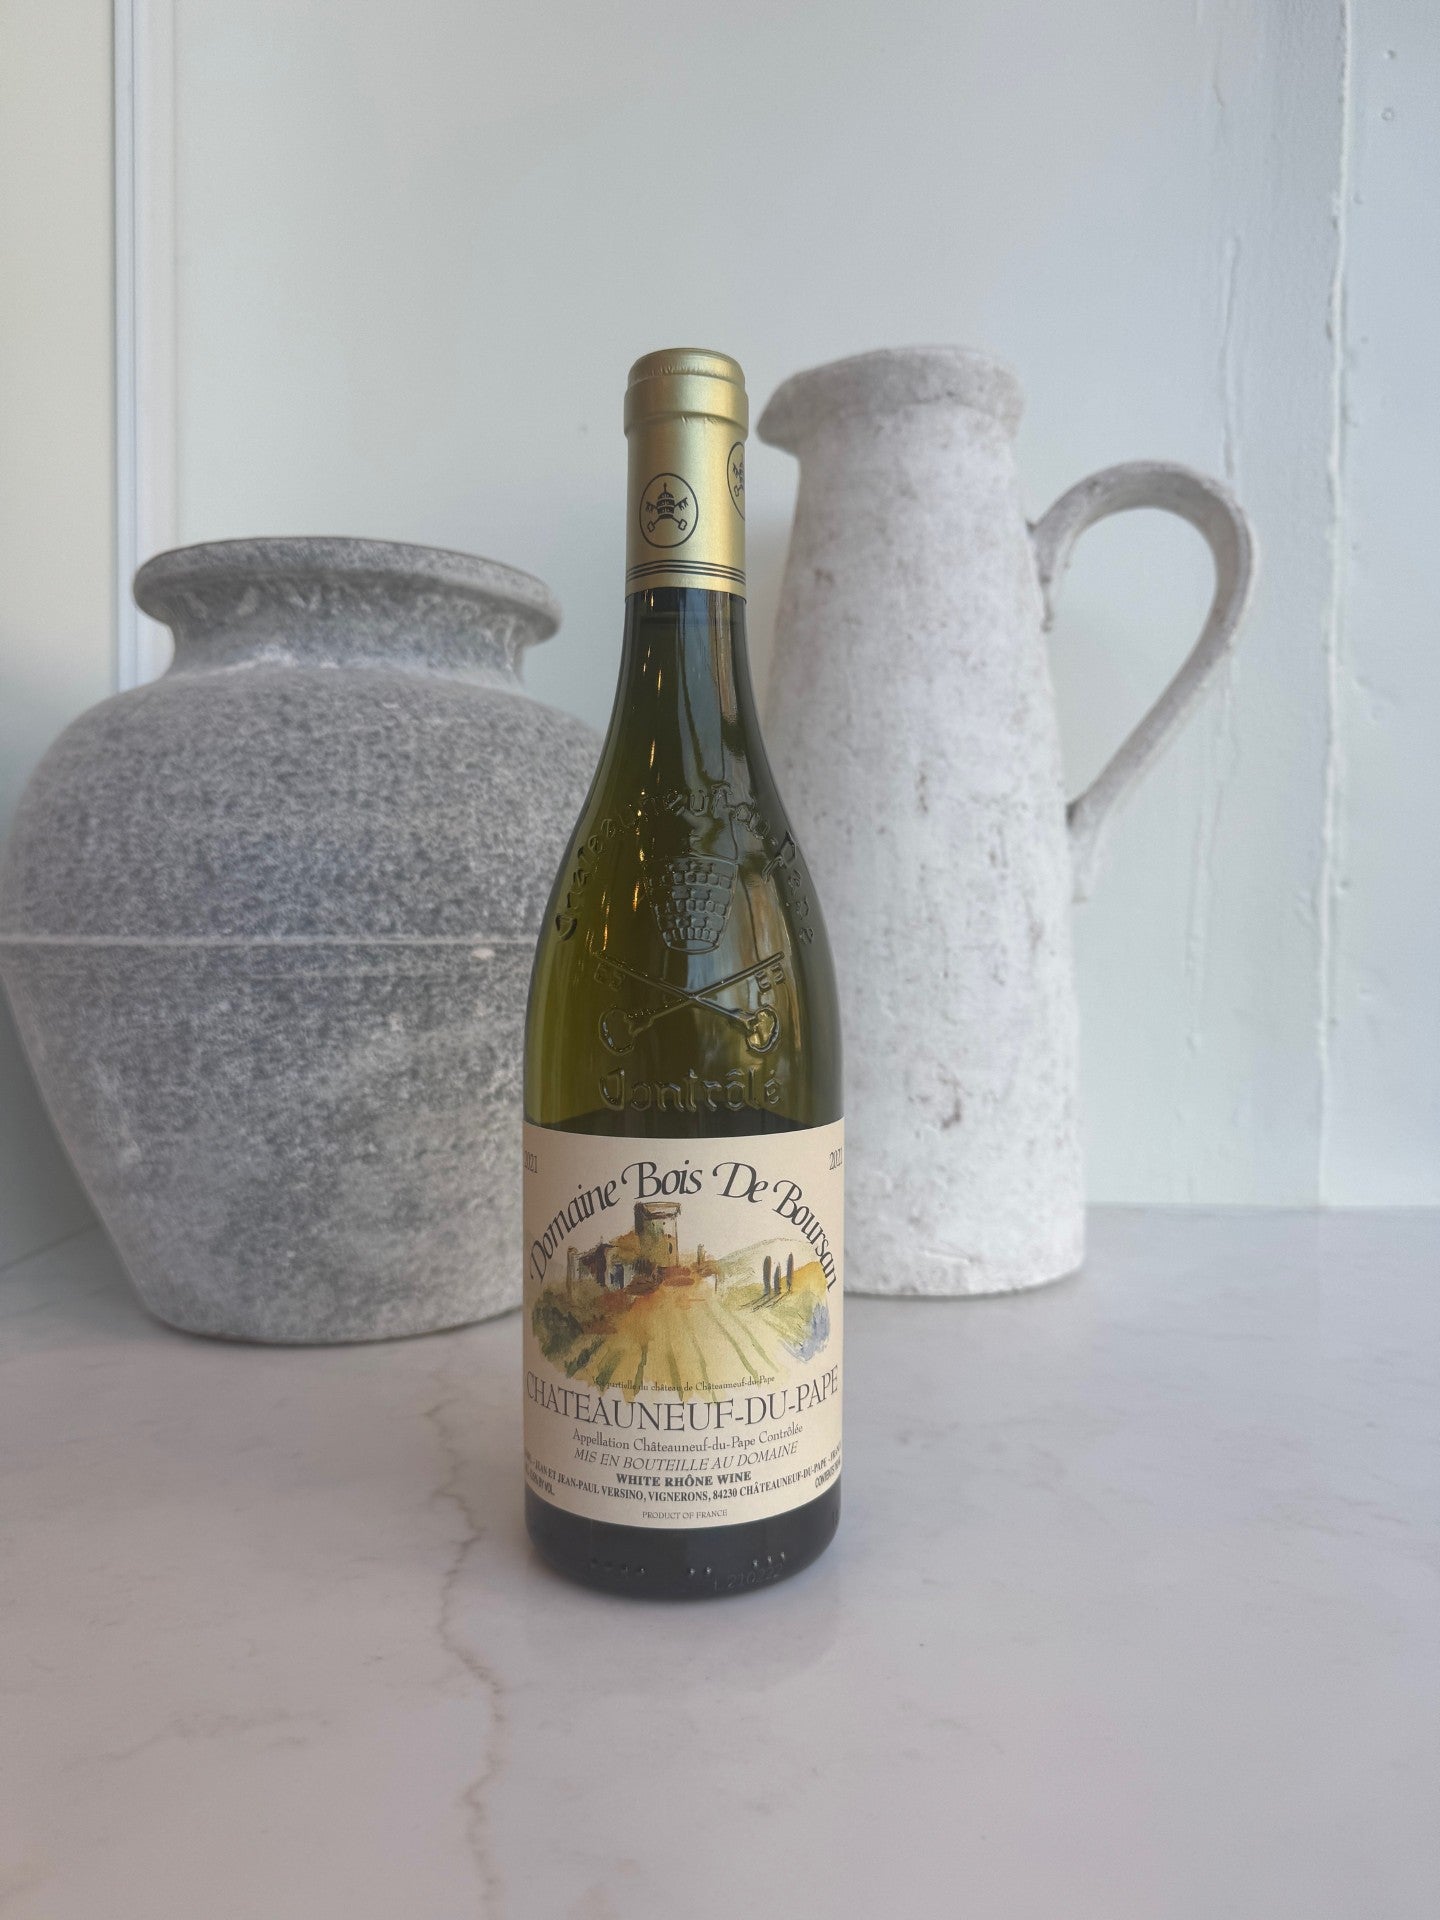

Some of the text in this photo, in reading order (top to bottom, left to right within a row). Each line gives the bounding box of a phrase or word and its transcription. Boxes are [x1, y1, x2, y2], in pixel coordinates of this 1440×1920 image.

[529, 1160, 837, 1292] Domaine Bois De Boursan
[526, 1364, 838, 1432] CHATEAUNEUF-DU-PAPE
[651, 1381, 684, 1391] château
[684, 1381, 693, 1391] de
[572, 1421, 804, 1452] Appellation Châteauneuf-du-Pape Contrôlée
[574, 1440, 799, 1471] MIS EN BOUTEILLE AU DOMAINE
[548, 1467, 557, 1480] ET
[557, 1472, 600, 1494] JEAN-PAUL
[601, 1485, 647, 1502] VERSINO,
[648, 1490, 711, 1502] VIGNERONS,
[713, 1487, 738, 1499] 84230
[740, 1457, 827, 1497] CHÂTEAUNEUF-DU-PAPE
[616, 1470, 752, 1487] WHITE RHÔNE WINE
[642, 1509, 728, 1520] PRODUCT OF FRANCE
